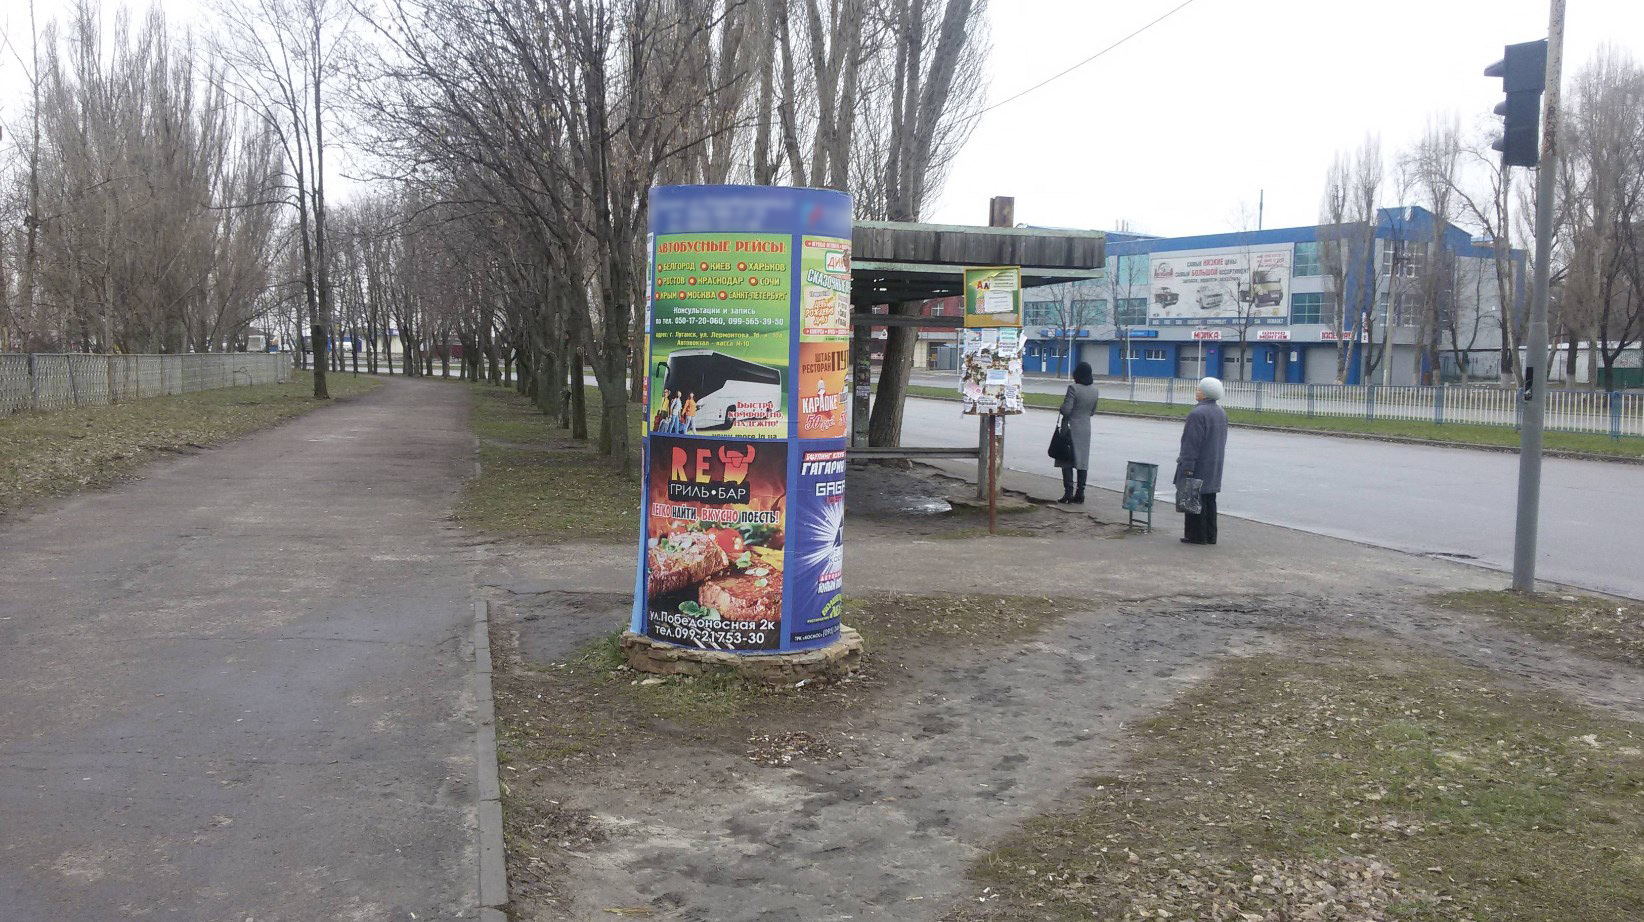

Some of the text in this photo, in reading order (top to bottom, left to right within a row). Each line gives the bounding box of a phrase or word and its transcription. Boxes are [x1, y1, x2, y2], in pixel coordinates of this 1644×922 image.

[658, 240, 731, 254] АВТОБУСНЫЕ
[663, 262, 786, 272] БЕЛГОРОД КИЕВ ХАРЬКОВ
[1203, 259, 1224, 267] НИЗКИЕ
[1191, 267, 1218, 276] БОЛЬШОЙ
[663, 277, 780, 286] РОСТОВ КРАСНОДАР СОЧИ
[660, 291, 788, 301] КРЫМ МОСКВА САНКТ-ПЕТЕРБУРГ
[673, 306, 720, 316] Консультации
[1193, 331, 1219, 339] МОЙКА
[815, 352, 832, 363] ШТАБ
[802, 362, 832, 374] РЕСТОРАН
[802, 394, 838, 414] КАРАОКЕ
[670, 483, 746, 500] ГРИЛЬ БАР
[652, 503, 780, 523] ЛЕГКО НАЙТИ, ВКУСНО ПОЕСТЬ!
[760, 619, 775, 630] 2к
